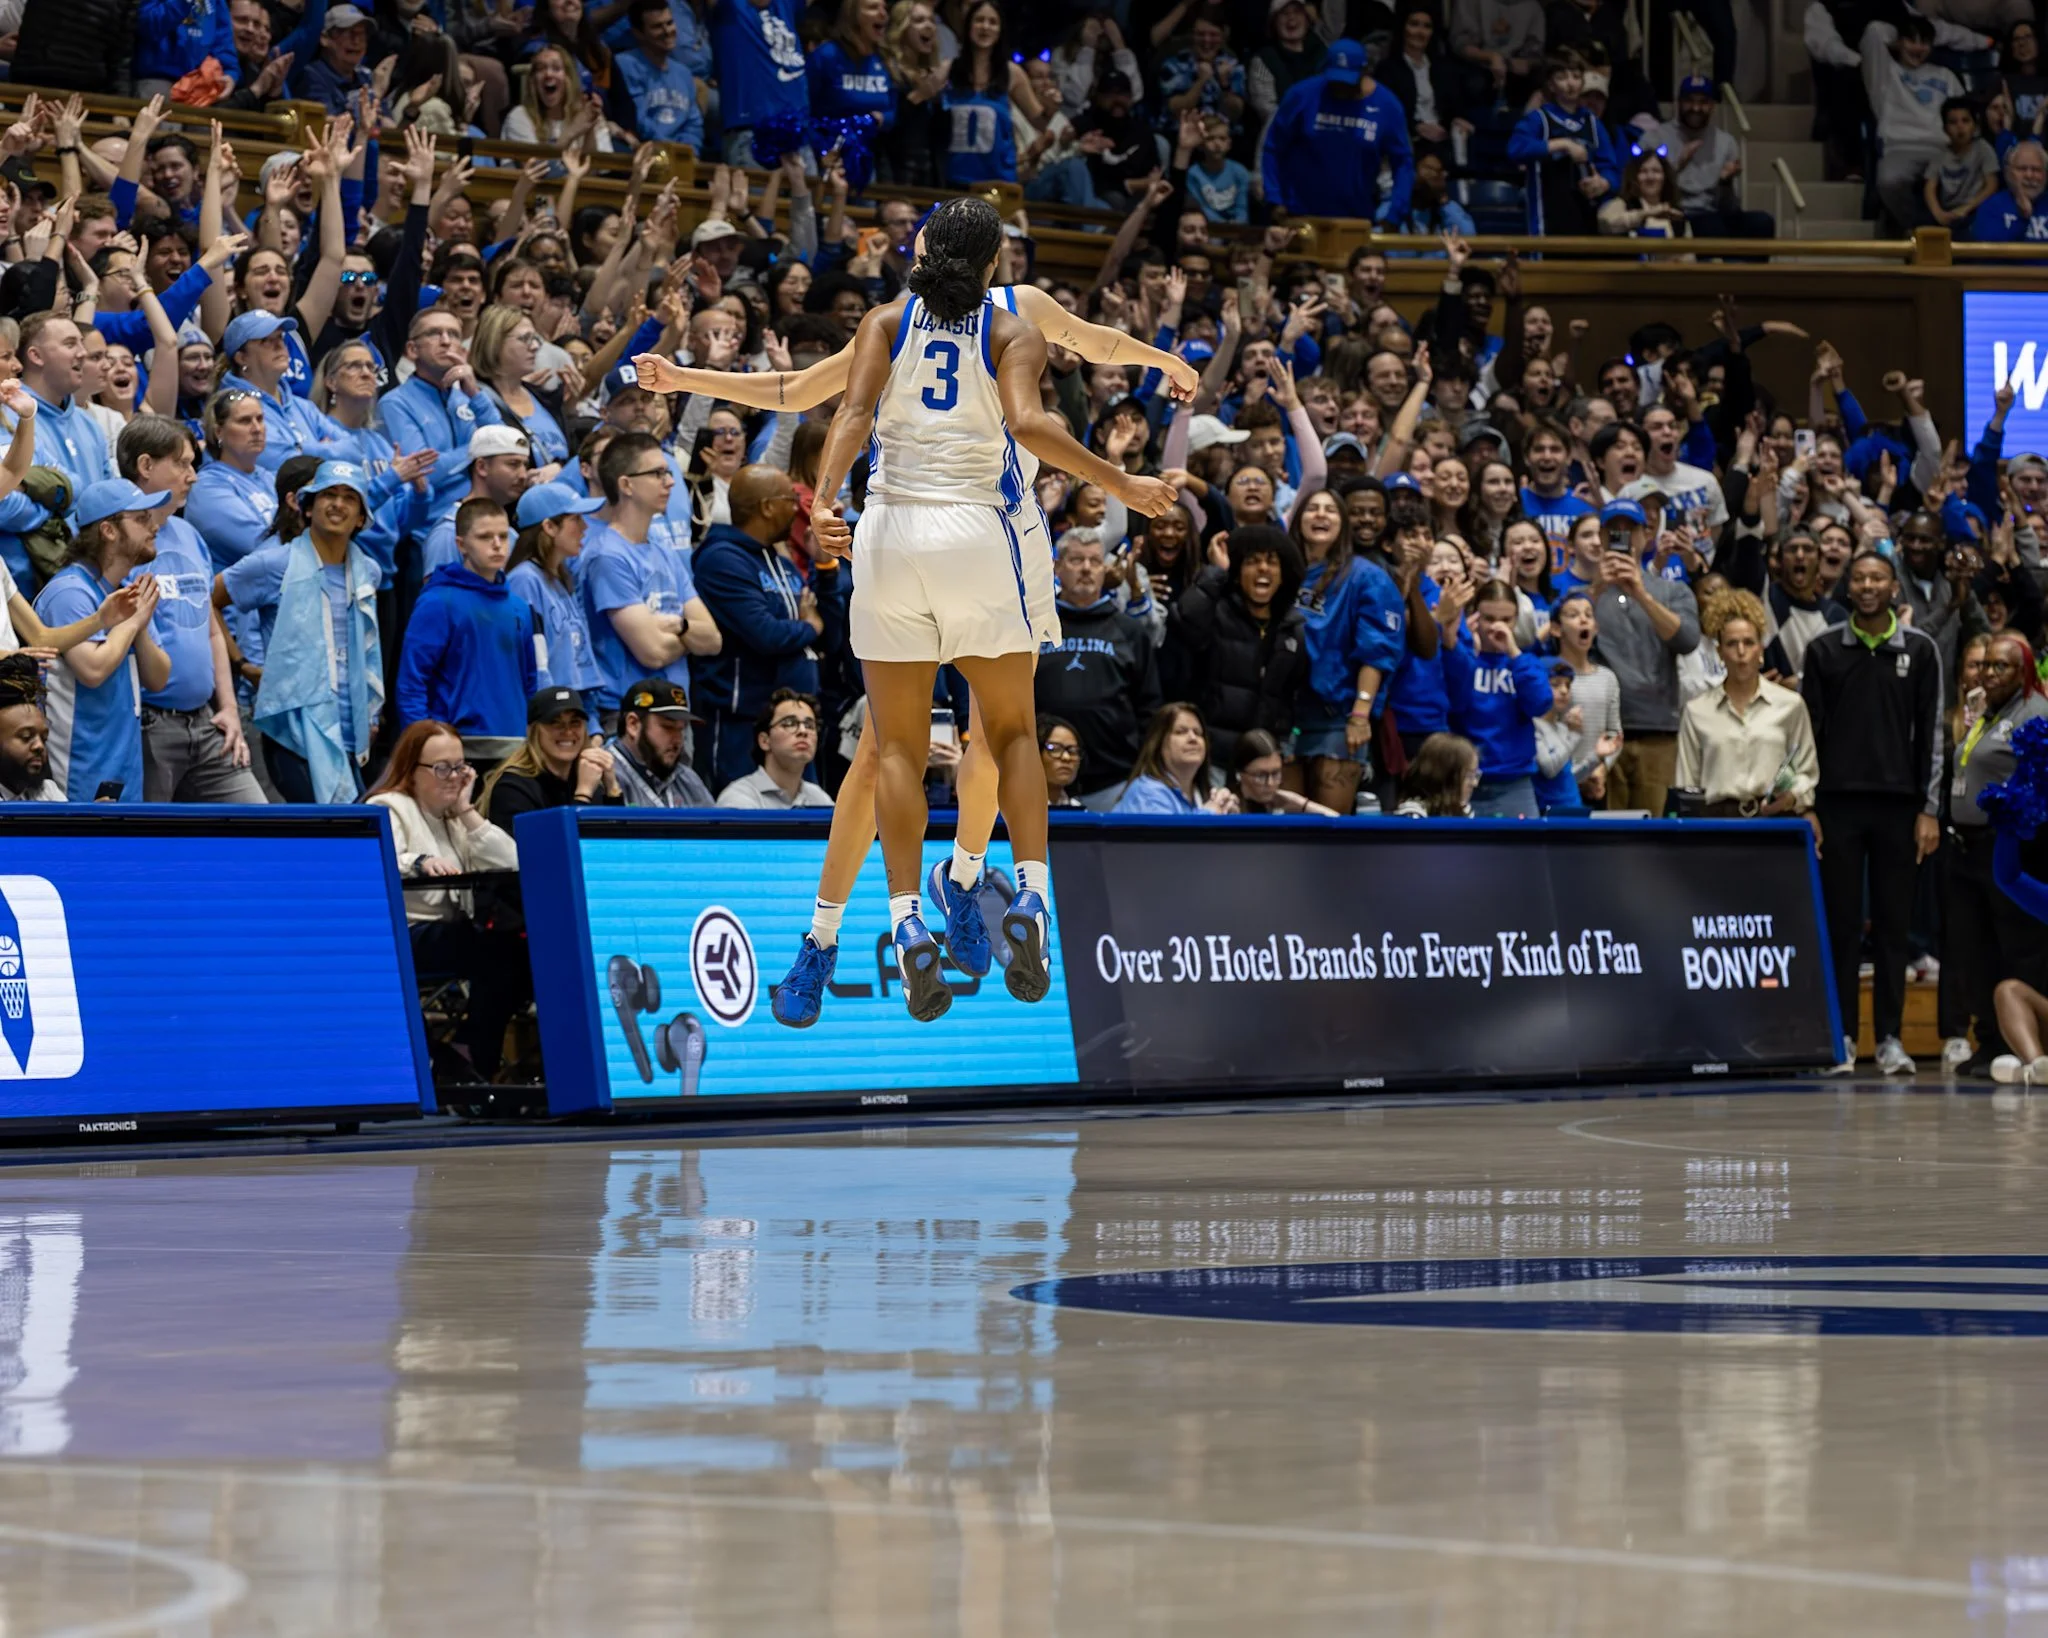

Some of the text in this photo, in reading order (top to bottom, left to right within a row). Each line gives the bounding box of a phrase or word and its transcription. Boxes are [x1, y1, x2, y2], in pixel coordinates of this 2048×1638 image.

[842, 74, 889, 93] DUKE
[921, 340, 961, 411] 3
[1692, 914, 1773, 939] MARRIOTT
[1096, 929, 1643, 988] Over 30 Hotel Brands for Every Kind of Fan
[1681, 945, 1791, 990] BONVOY
[79, 1120, 138, 1132] DAKTRONICS
